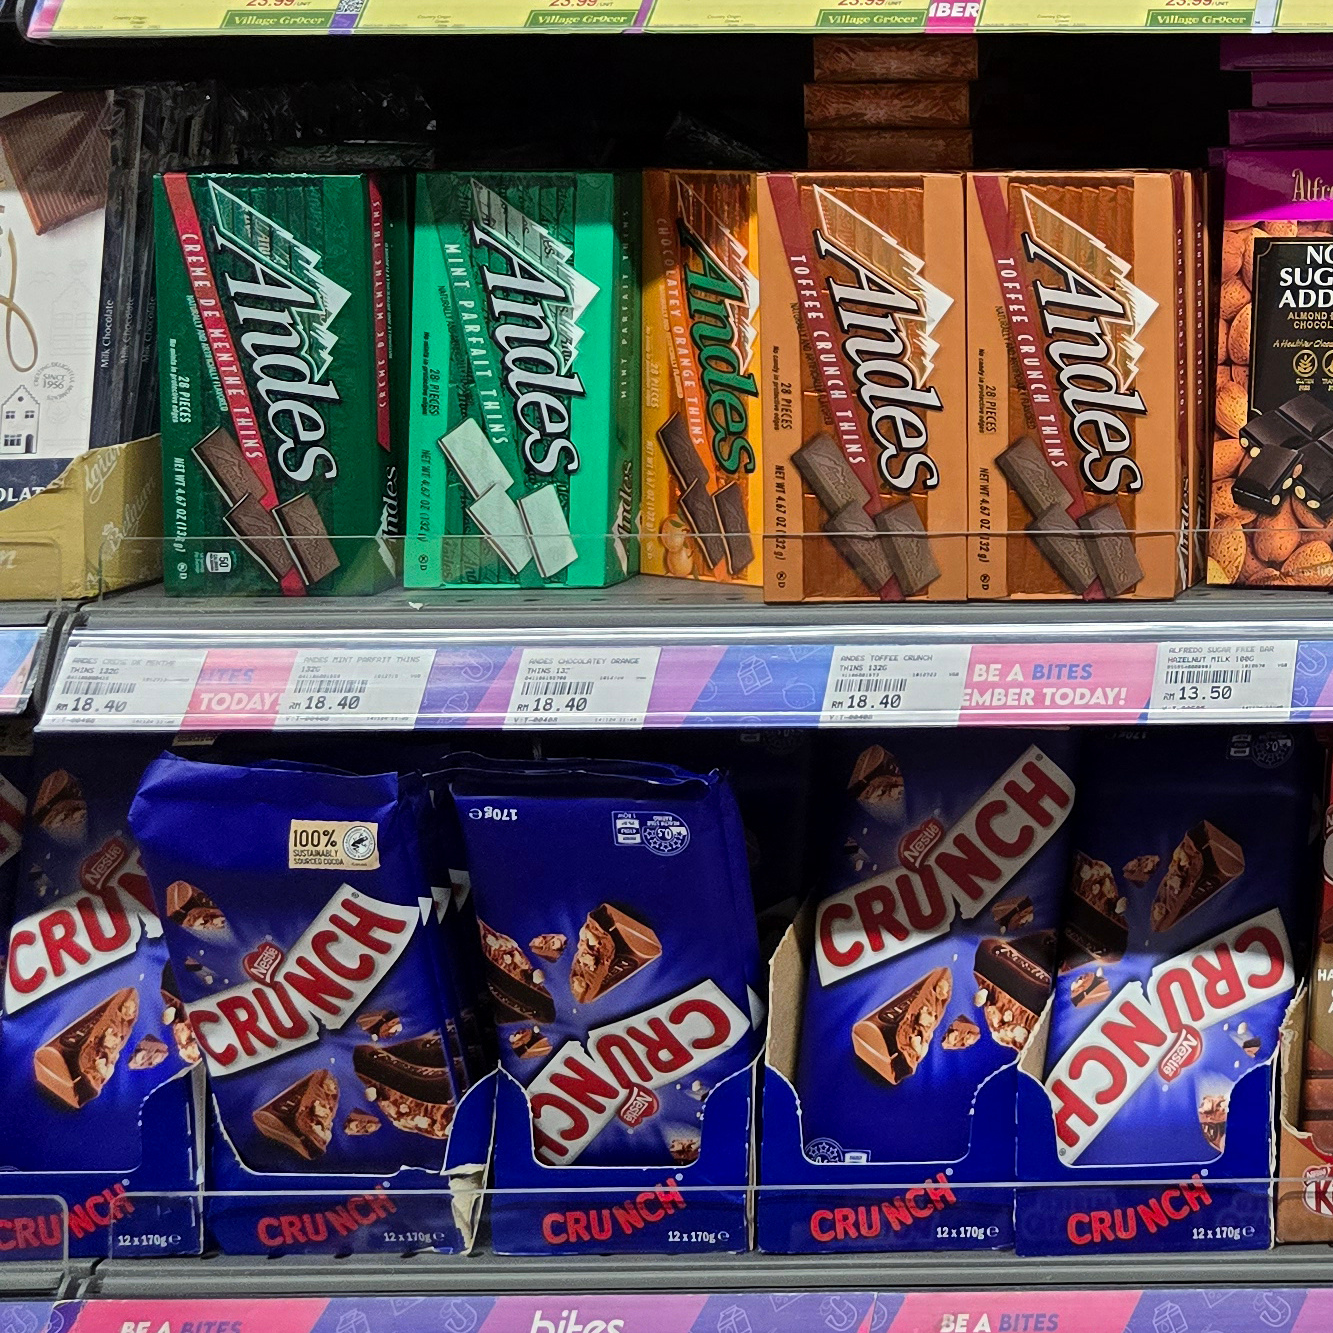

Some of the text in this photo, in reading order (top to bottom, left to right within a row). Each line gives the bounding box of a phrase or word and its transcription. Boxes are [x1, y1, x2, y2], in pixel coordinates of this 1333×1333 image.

[234, 16, 279, 26] Village
[181, 233, 262, 458] CREME DE MENTHE THINS
[212, 225, 342, 482] Andes
[304, 695, 360, 710] 18.40
[292, 829, 338, 849] 100%
[292, 849, 340, 858] SUSTAINABLY
[292, 857, 318, 865] SOURCED
[818, 760, 1072, 967] CRUNCH
[188, 897, 408, 1067] CRUNCH
[809, 1171, 957, 1242] CRUNCH
